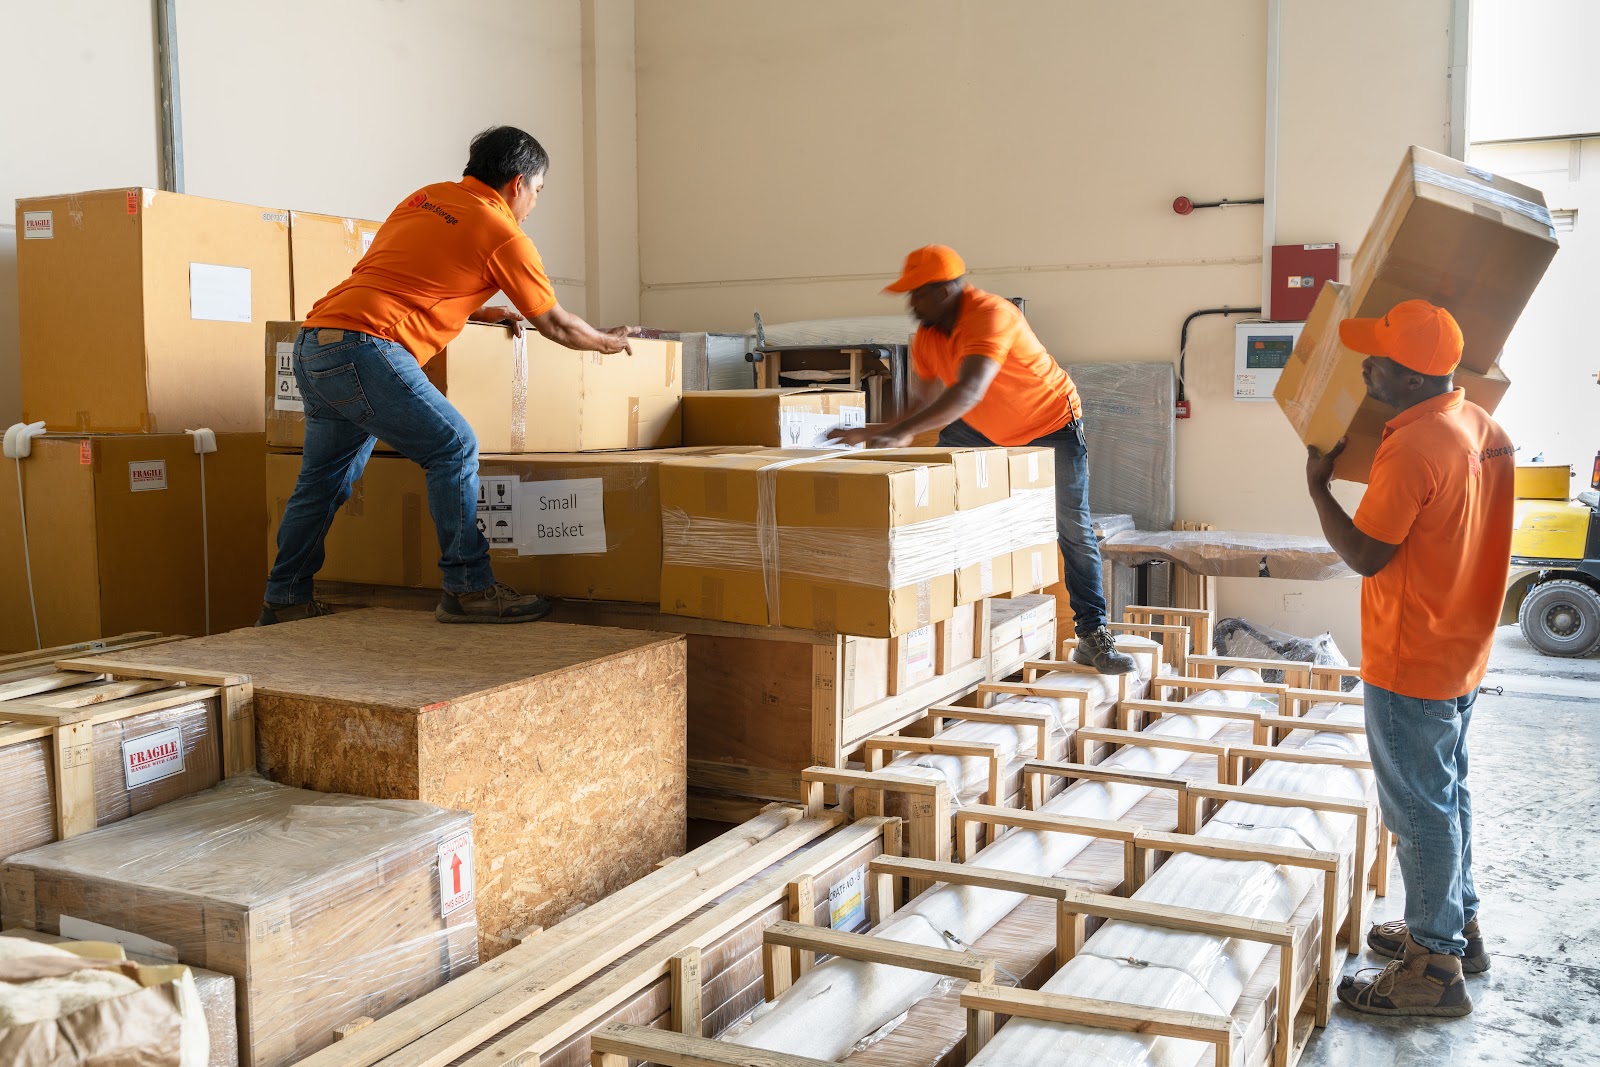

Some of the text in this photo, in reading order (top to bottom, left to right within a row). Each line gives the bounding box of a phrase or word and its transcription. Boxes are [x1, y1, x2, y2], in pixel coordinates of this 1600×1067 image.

[132, 468, 163, 477] FRAGILE
[539, 493, 577, 511] Small
[537, 522, 584, 538] Basket
[129, 740, 178, 765] FRAGILE
[131, 764, 151, 773] HANDLE
[166, 754, 179, 762] CARE
[442, 835, 468, 856] CAUTION
[444, 890, 471, 911] THIS SIDE UP
